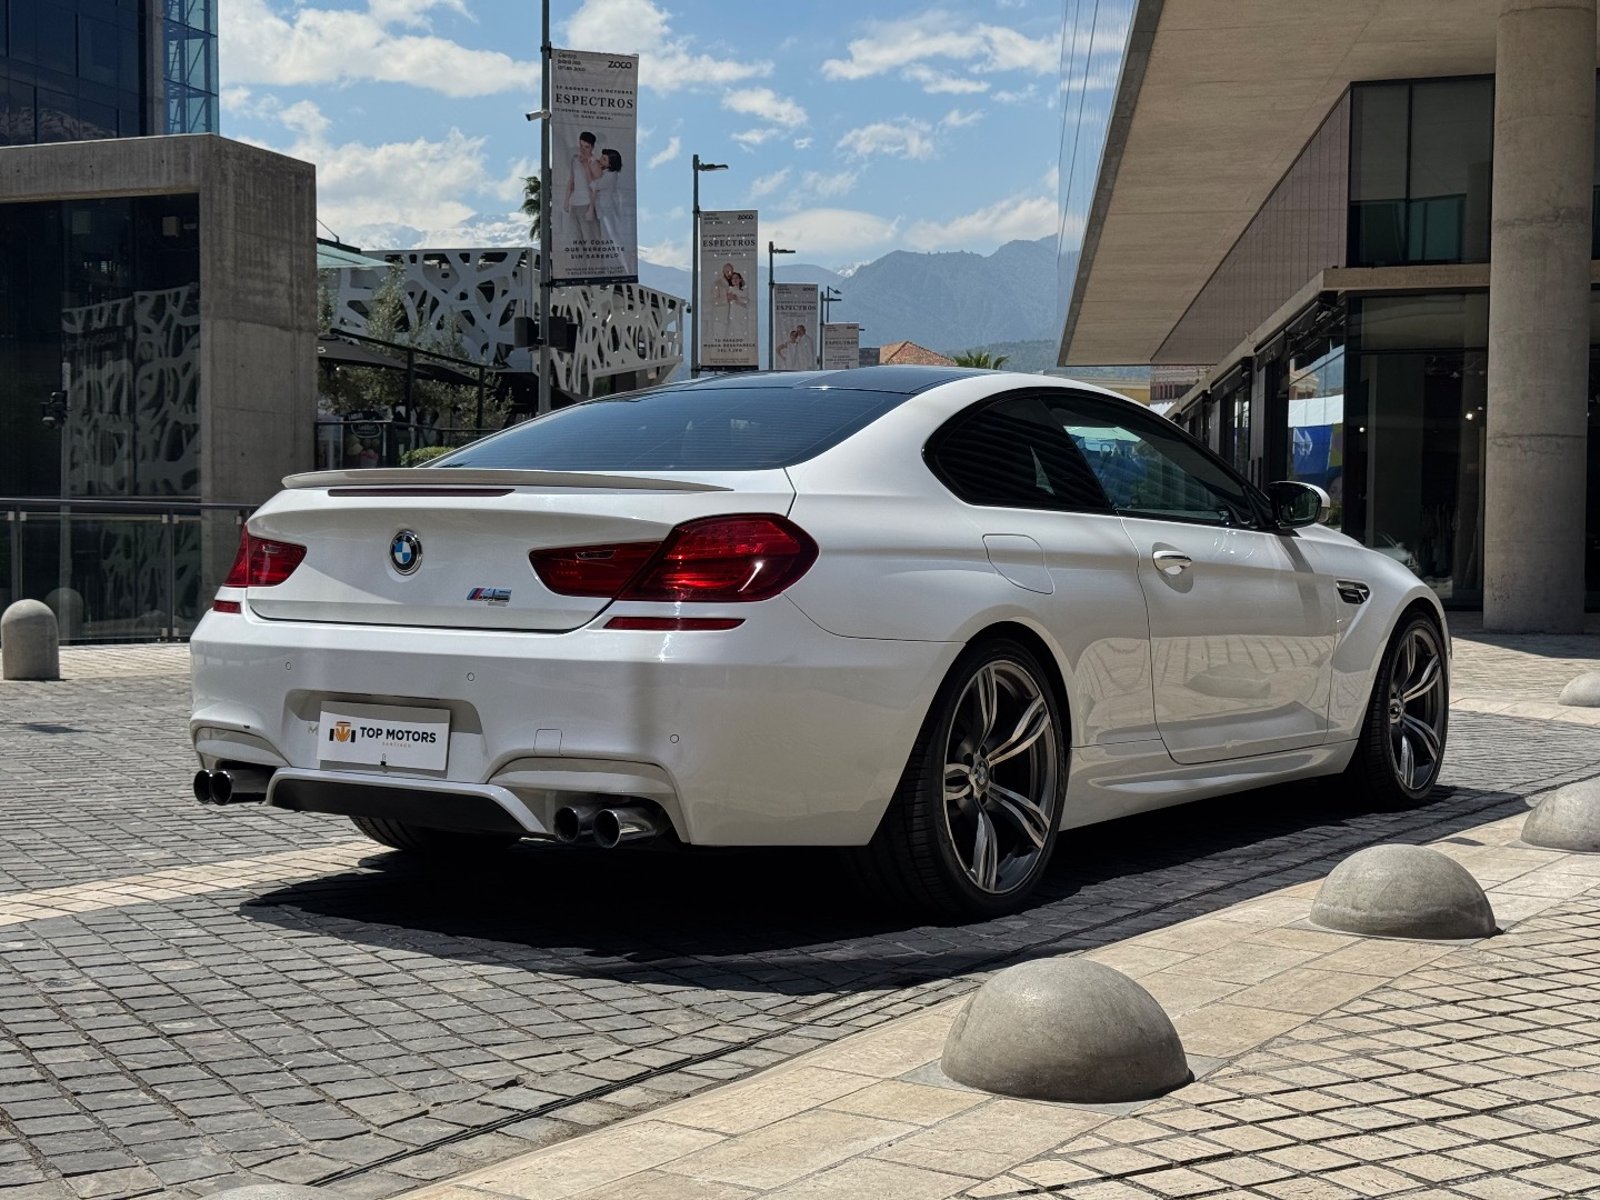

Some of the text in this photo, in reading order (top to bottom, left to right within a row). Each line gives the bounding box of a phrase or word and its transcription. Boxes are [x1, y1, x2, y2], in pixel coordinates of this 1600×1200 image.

[608, 60, 632, 69] ZOCO
[555, 93, 633, 109] ESPECTROS
[703, 239, 756, 247] ESPECTROS
[359, 726, 437, 743] TOP MOTORS
